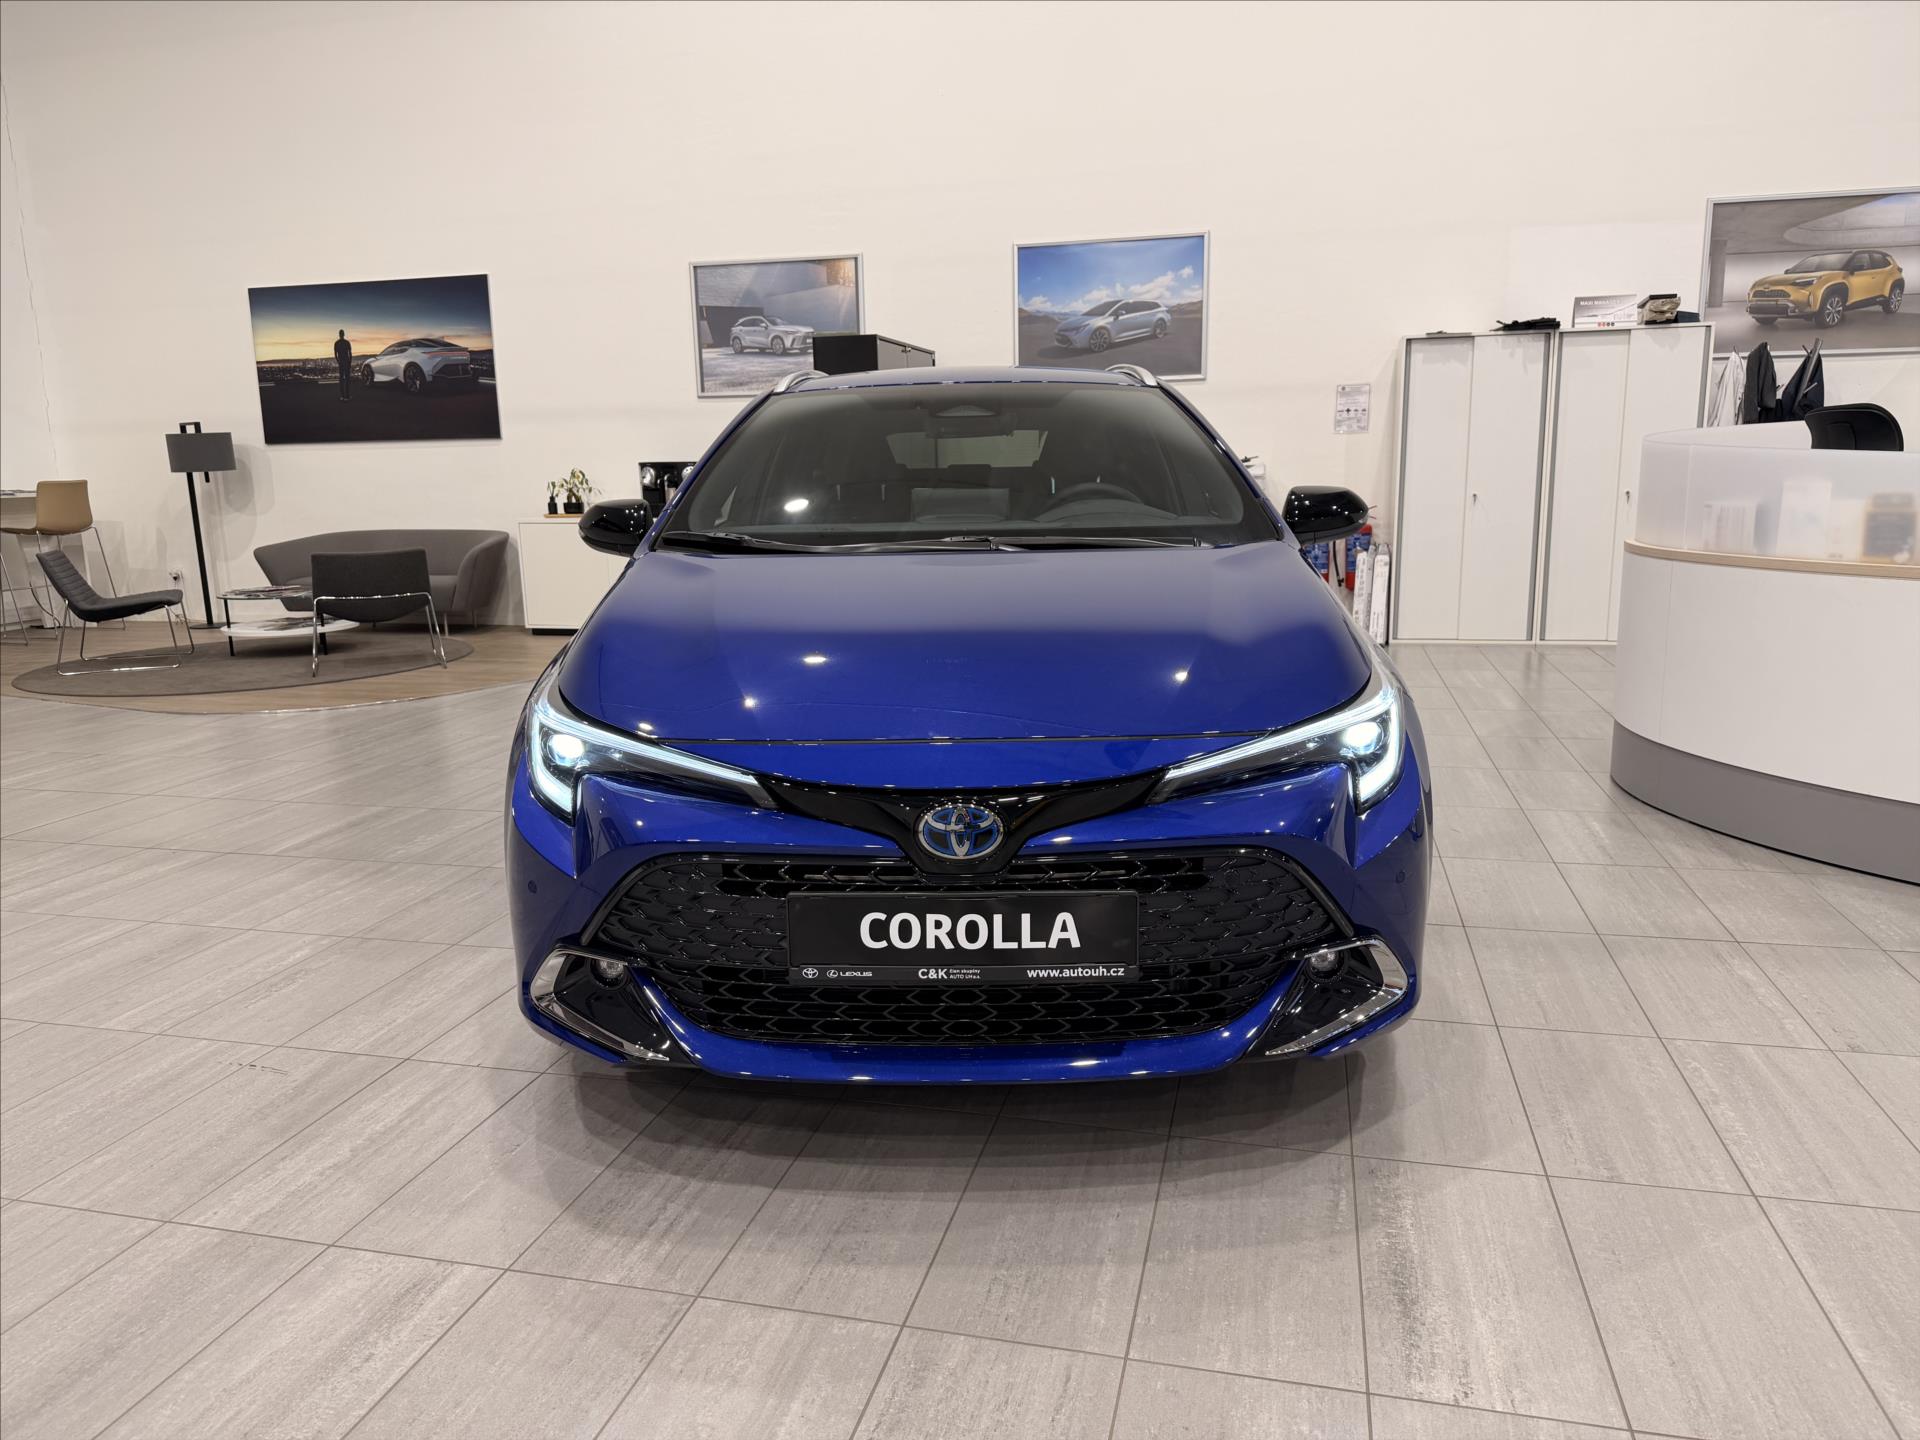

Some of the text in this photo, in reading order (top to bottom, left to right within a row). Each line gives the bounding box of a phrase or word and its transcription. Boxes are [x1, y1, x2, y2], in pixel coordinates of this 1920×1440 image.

[860, 911, 1081, 950] COROLLA
[918, 968, 948, 979] C&K
[1026, 966, 1125, 978] www.autouh.cz
